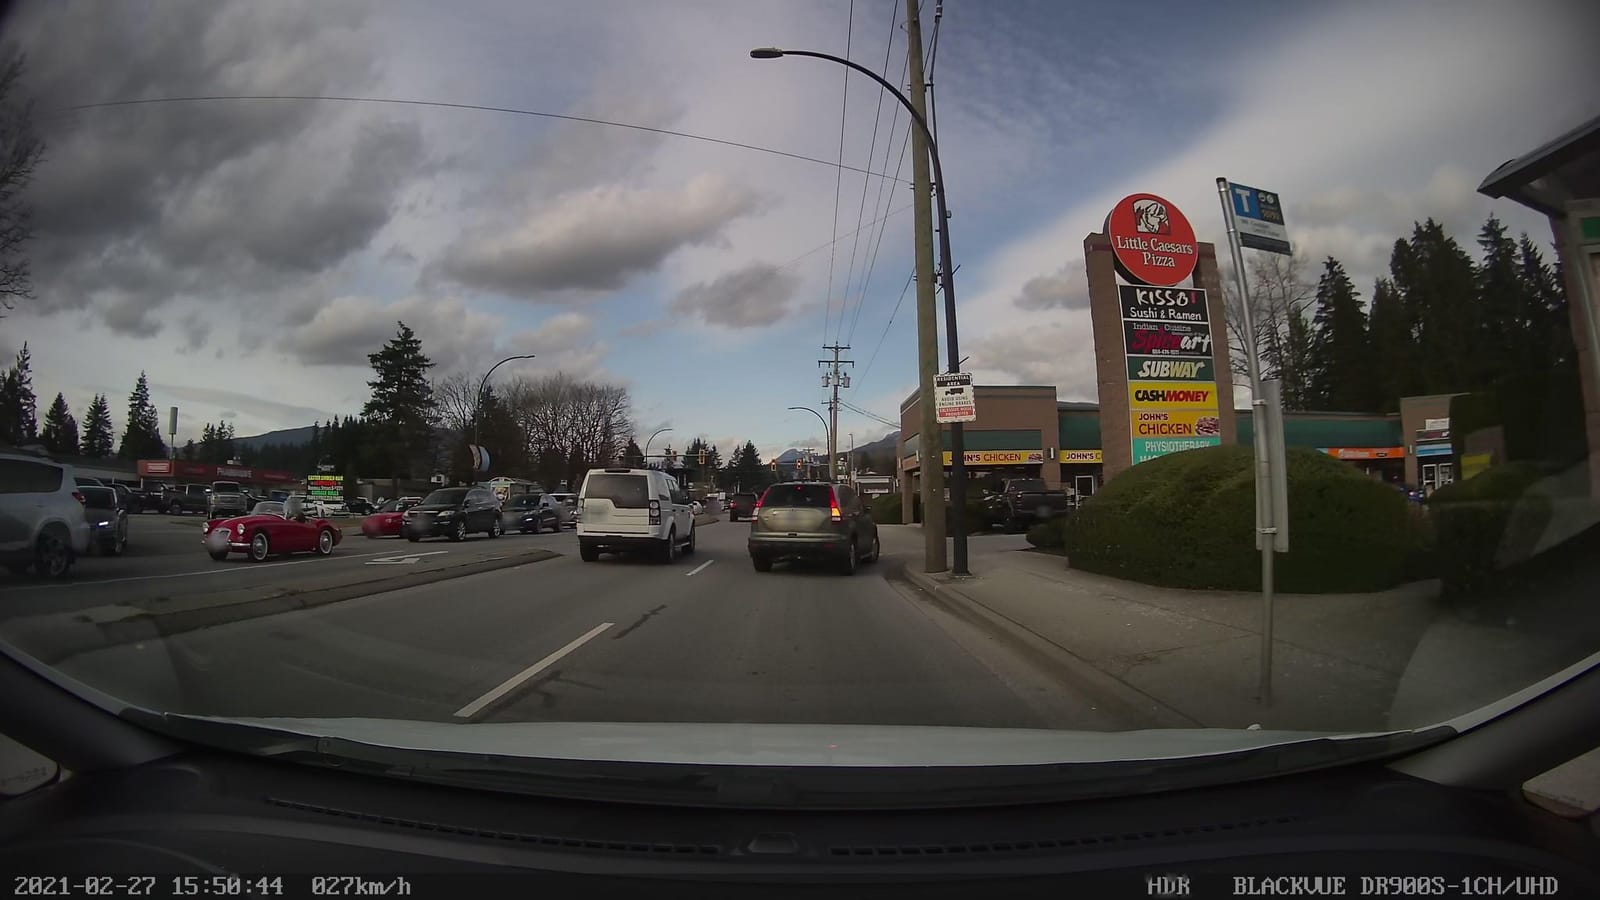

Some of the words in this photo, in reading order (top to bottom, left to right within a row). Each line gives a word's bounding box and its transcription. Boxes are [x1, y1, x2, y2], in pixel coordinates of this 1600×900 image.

[1235, 188, 1250, 213] T
[1116, 235, 1148, 250] Little
[1150, 238, 1193, 255] Caesars
[1142, 251, 1175, 267] Pizza
[1130, 307, 1157, 319] Sushi
[1160, 309, 1166, 318] &
[1169, 308, 1201, 320] Ramen
[1133, 323, 1158, 331] Indian
[1137, 360, 1206, 378] SUBWAY
[1138, 413, 1169, 421] JOHN'S
[1138, 423, 1192, 435] CHICKEN
[1145, 441, 1210, 452] PHYSIOTHERAPY
[983, 453, 1021, 462] CHICKEN
[1066, 452, 1094, 460] JOHN'S
